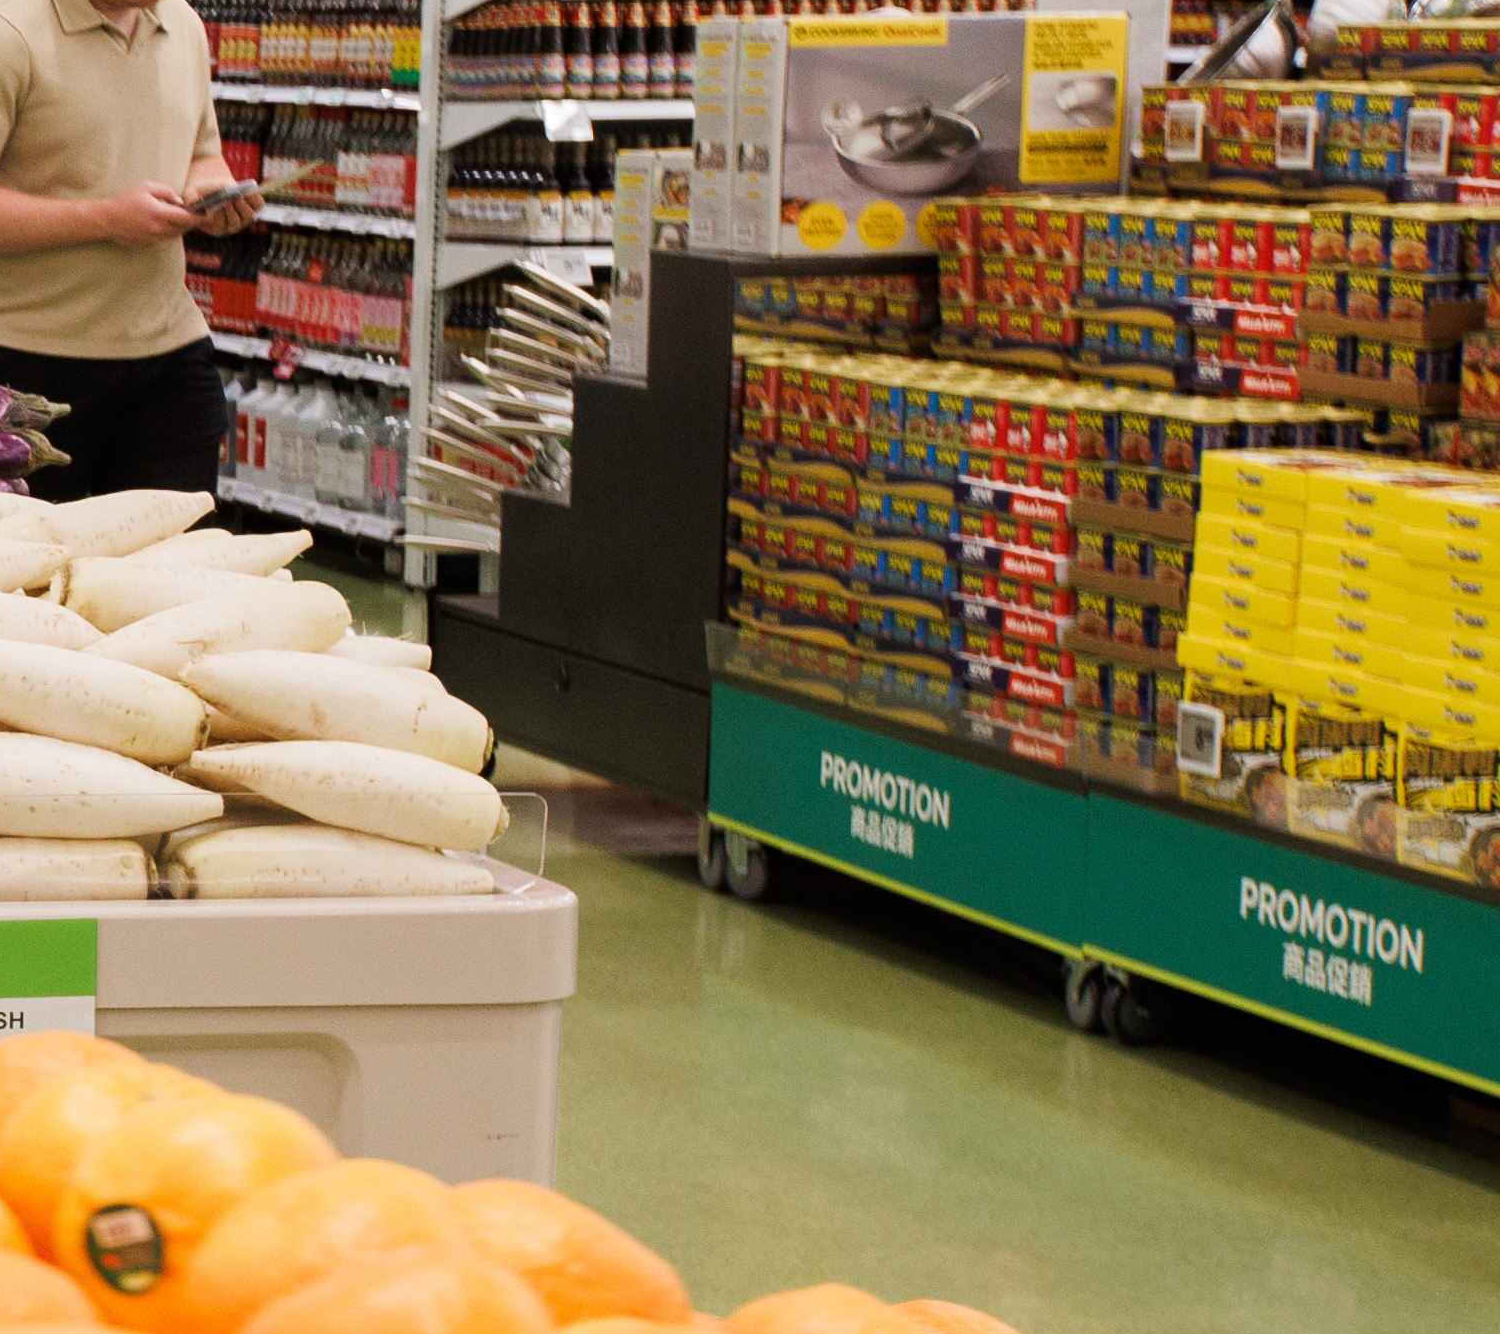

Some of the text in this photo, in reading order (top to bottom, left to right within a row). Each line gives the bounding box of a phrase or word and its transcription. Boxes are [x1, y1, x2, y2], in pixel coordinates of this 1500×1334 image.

[819, 750, 951, 830] PROMOTION
[1238, 875, 1426, 975] PROMOTION
[1281, 941, 1375, 1008] 商品促銷
